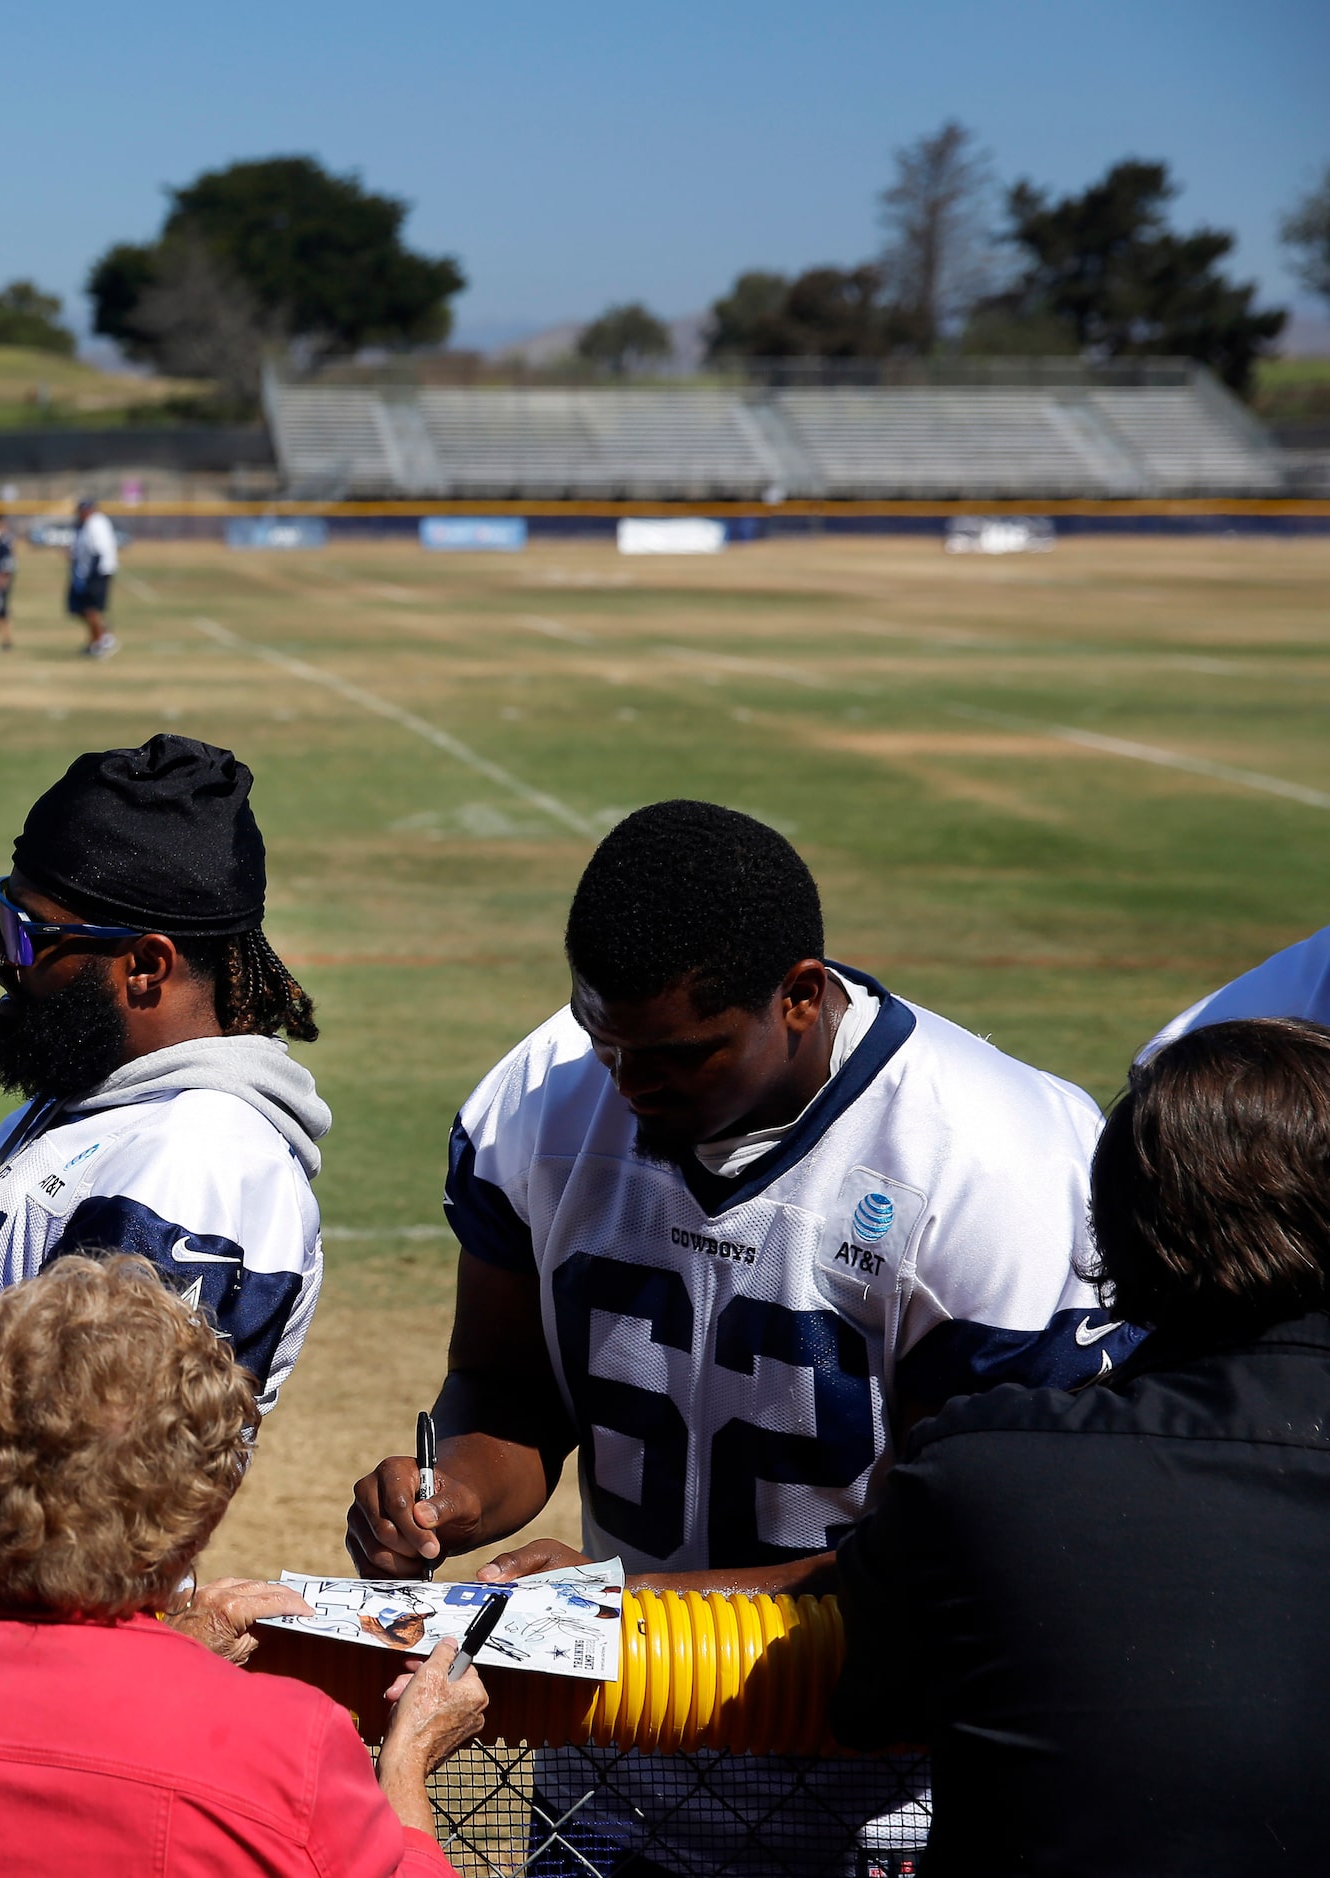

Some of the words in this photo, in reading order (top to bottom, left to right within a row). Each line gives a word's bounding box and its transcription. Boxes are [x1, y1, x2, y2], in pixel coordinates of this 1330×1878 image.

[38, 1173, 66, 1199] AT&T
[671, 1226, 757, 1265] COWBOYS
[834, 1240, 886, 1277] AT&T
[552, 1250, 877, 1572] 62
[573, 1640, 584, 1668] TRAINING
[584, 1655, 595, 1670] CAMP
